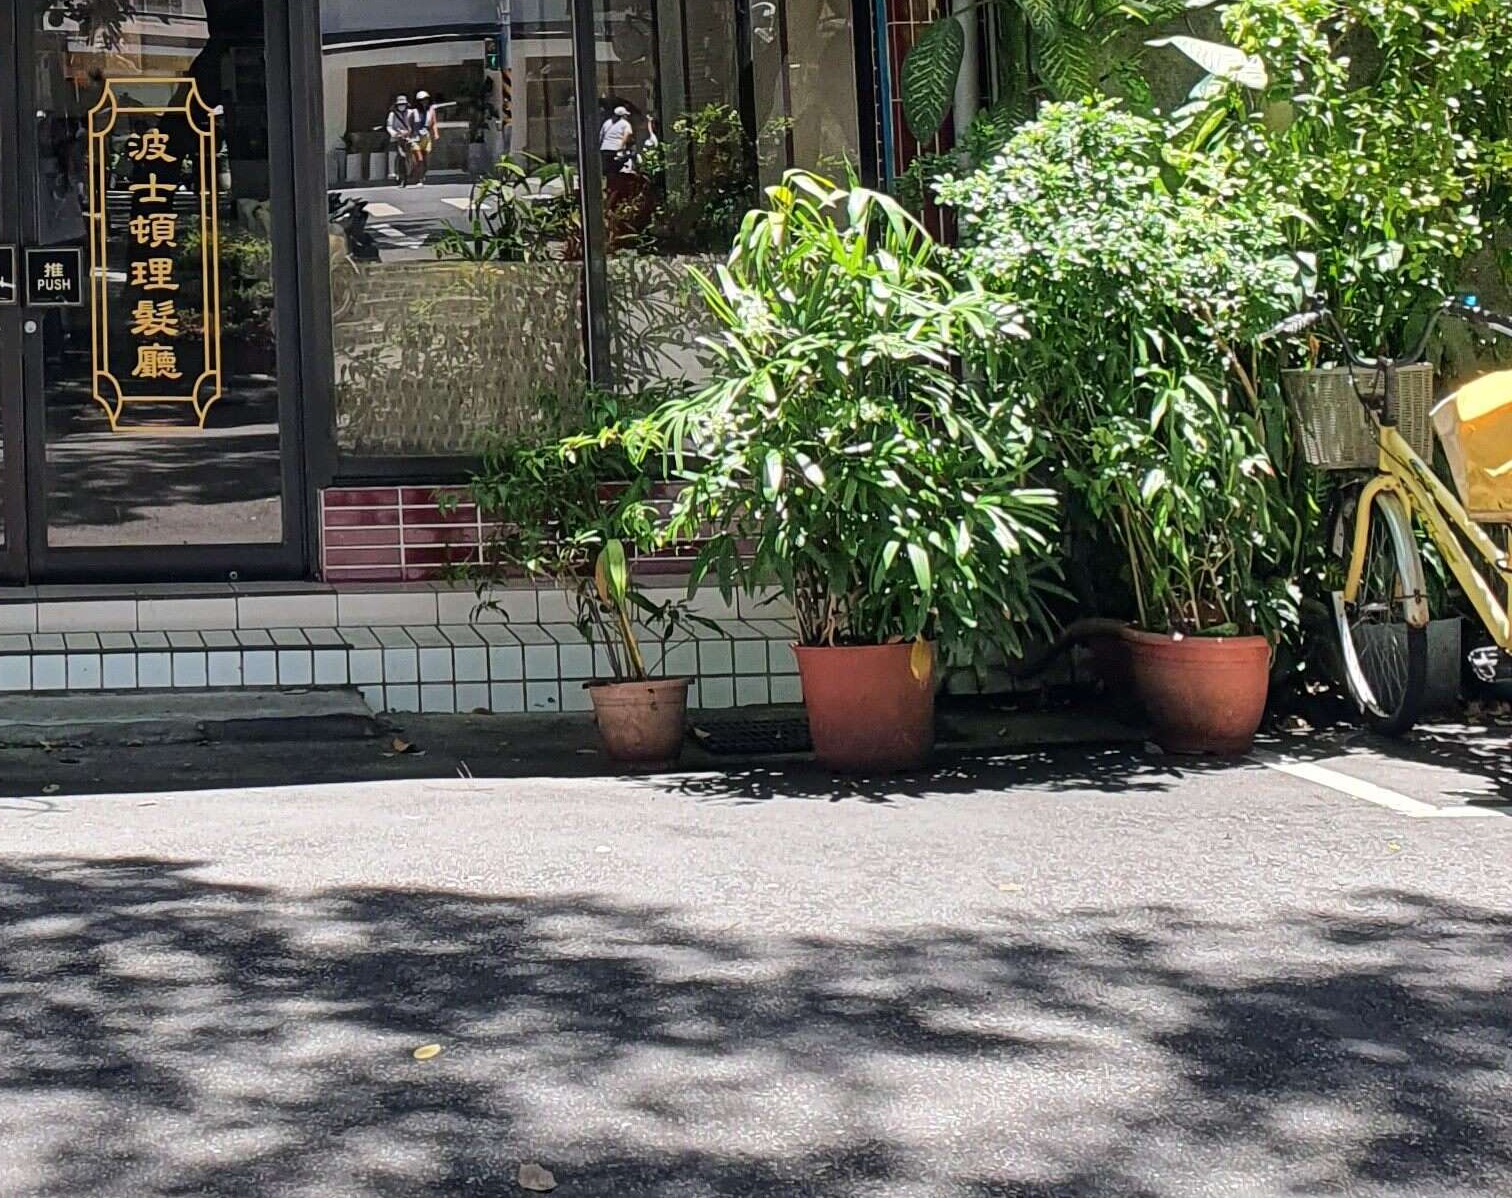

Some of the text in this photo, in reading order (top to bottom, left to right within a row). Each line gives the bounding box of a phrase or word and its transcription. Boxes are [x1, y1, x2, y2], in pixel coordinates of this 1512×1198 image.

[128, 128, 182, 379] 波士頓理髮廳
[44, 262, 64, 277] 推
[37, 278, 71, 291] PUSH
